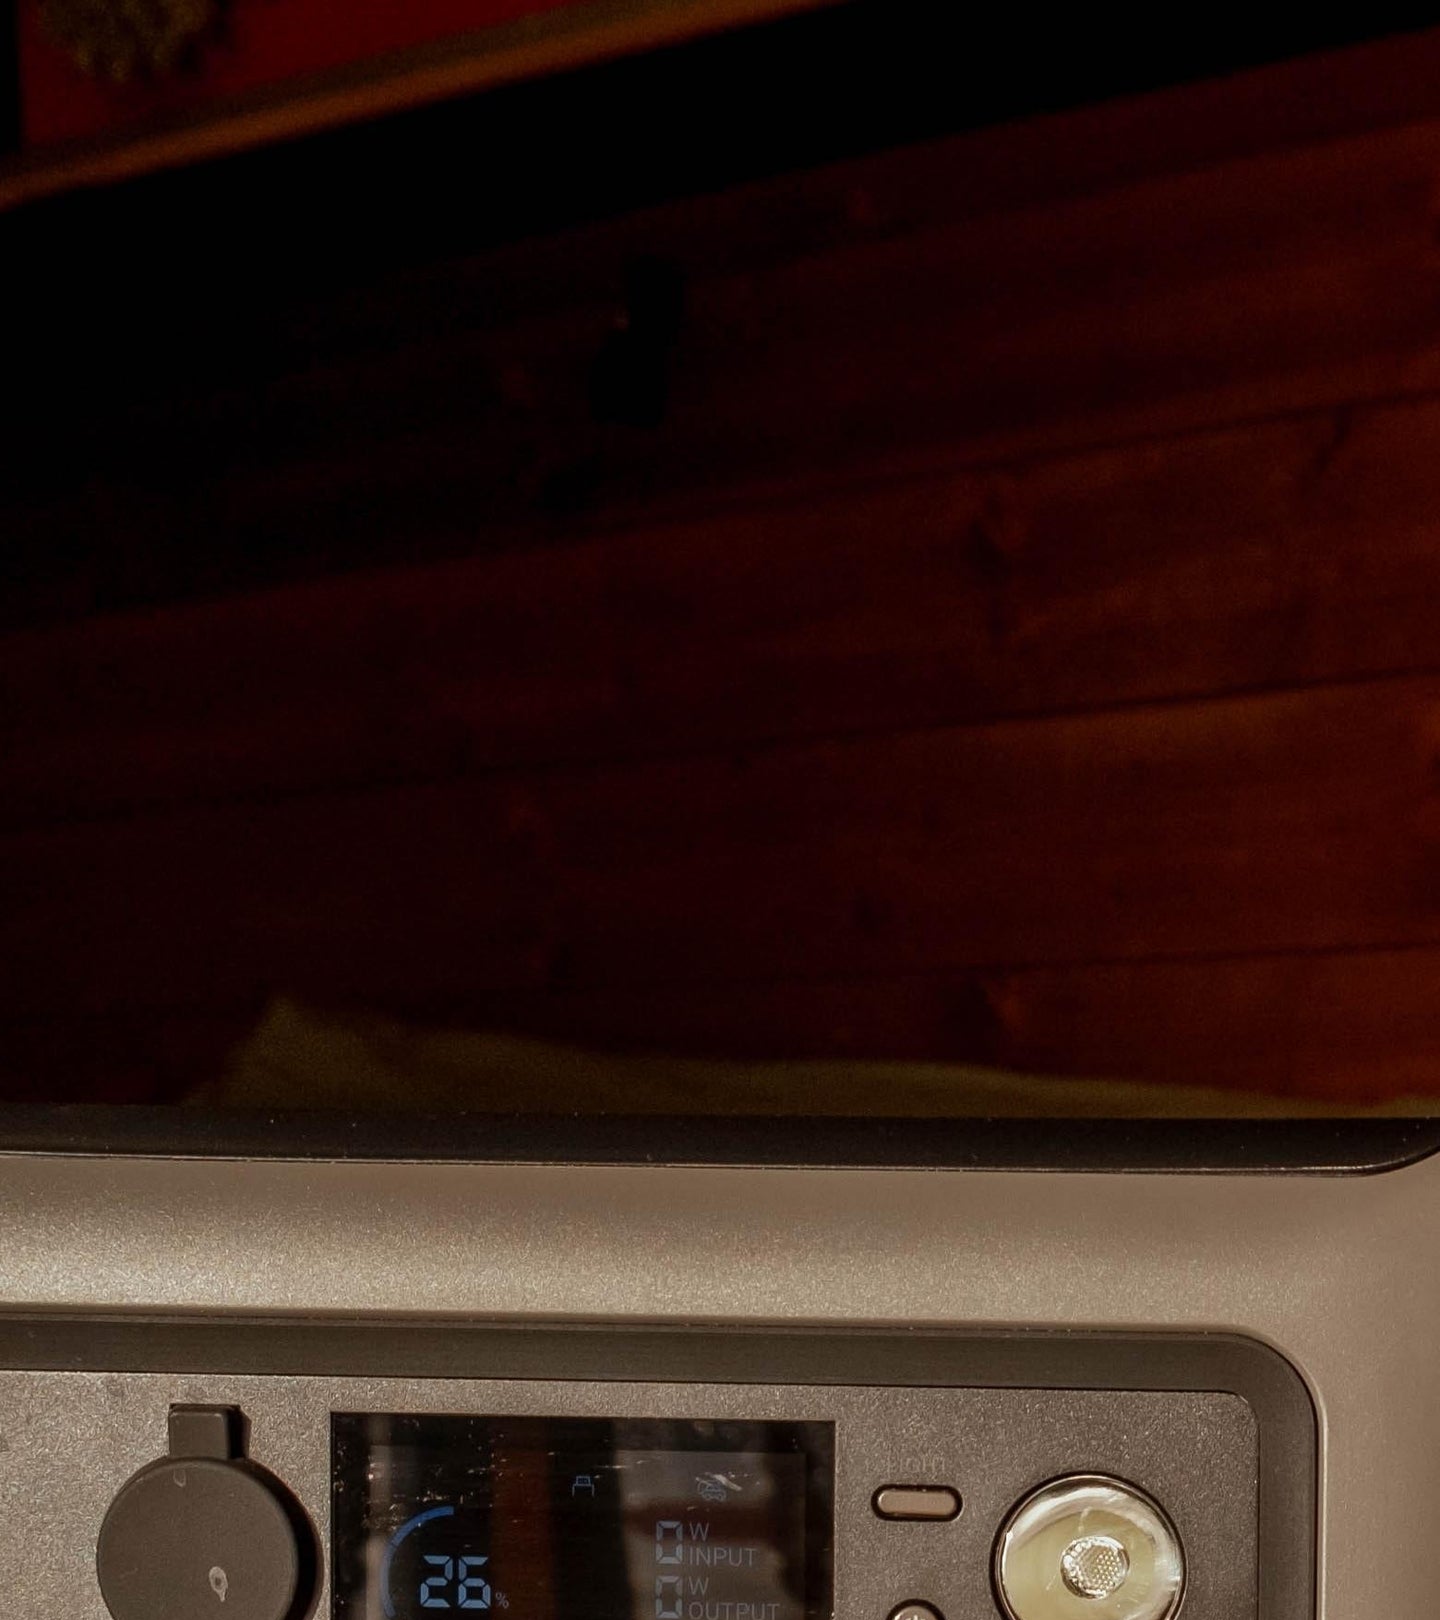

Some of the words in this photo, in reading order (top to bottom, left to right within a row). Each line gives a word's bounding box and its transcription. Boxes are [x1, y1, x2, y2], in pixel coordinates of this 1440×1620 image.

[656, 1520, 683, 1564] 0
[689, 1521, 710, 1541] W
[689, 1547, 757, 1567] INPUT
[655, 1576, 683, 1620] 0
[689, 1577, 710, 1596] W
